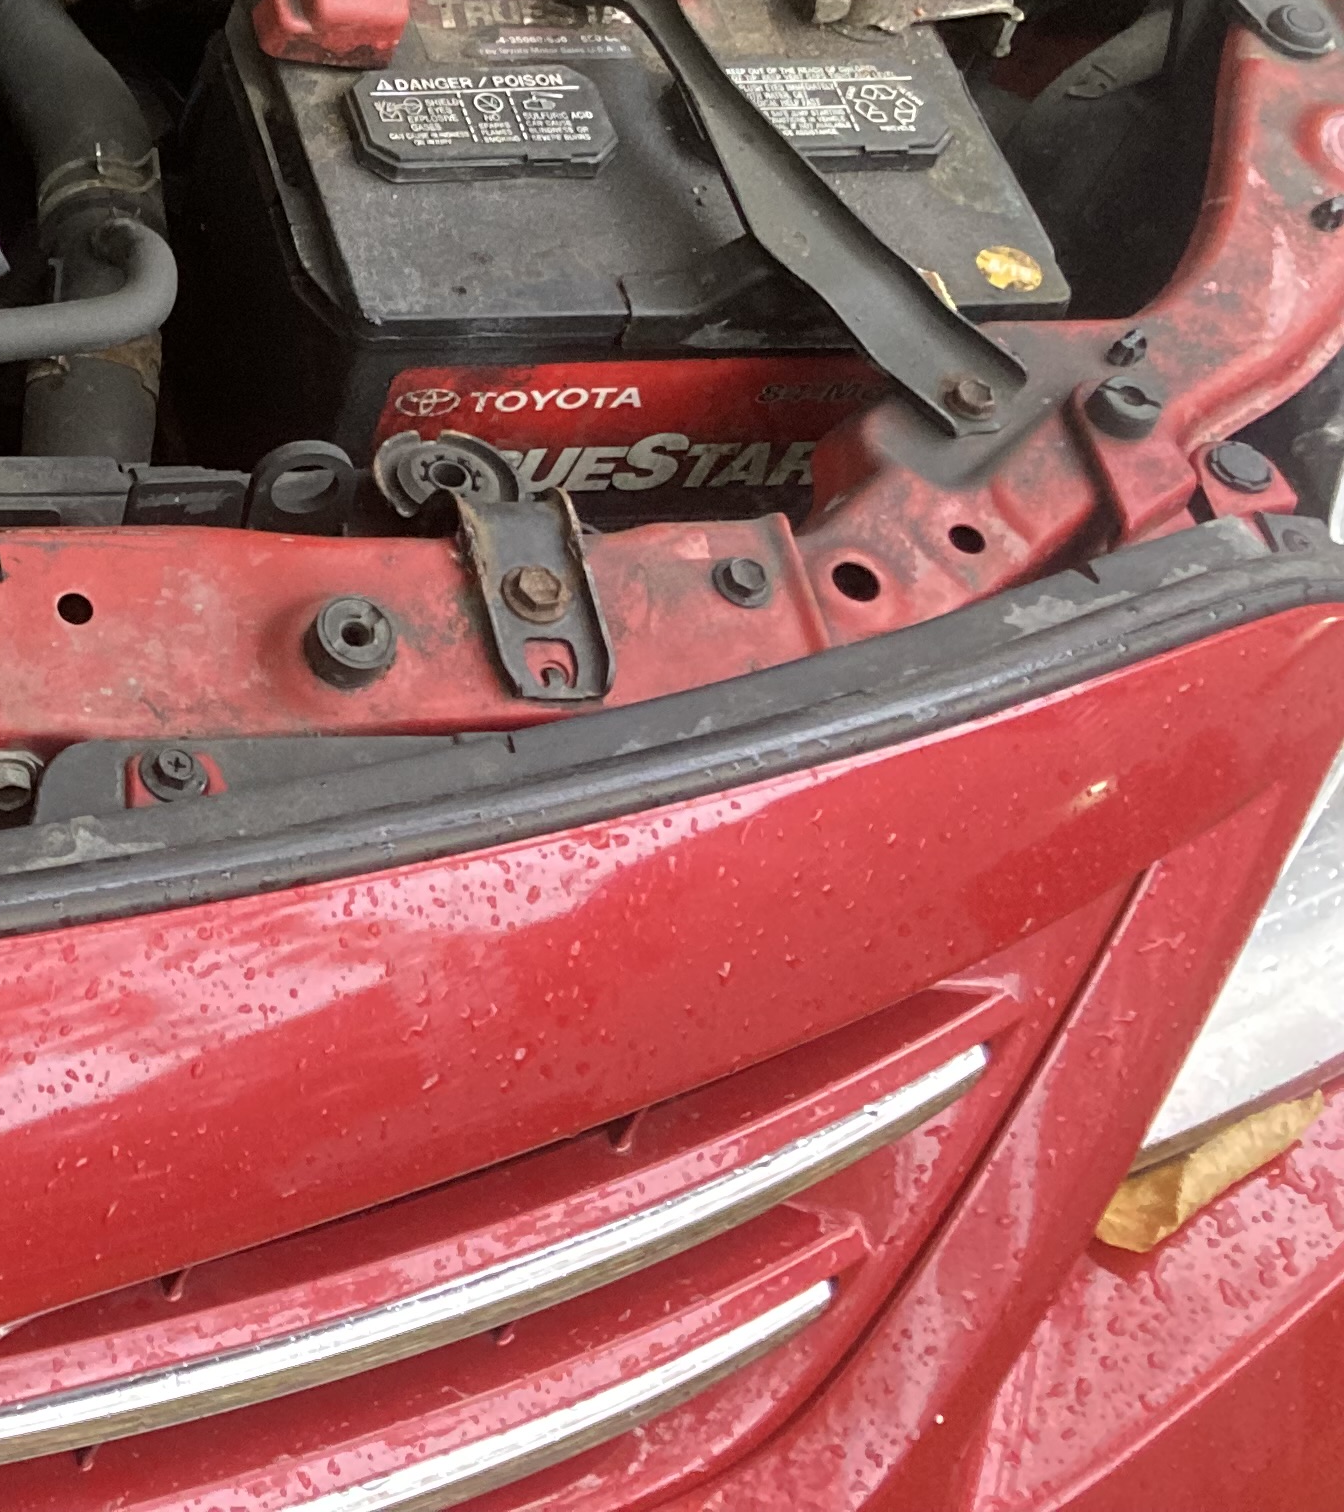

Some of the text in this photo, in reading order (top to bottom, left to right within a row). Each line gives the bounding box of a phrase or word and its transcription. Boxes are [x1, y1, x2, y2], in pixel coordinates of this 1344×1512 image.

[394, 73, 564, 91] DANGER / POISON
[424, 98, 461, 107] SHIELD
[428, 107, 453, 115] EYES
[522, 110, 594, 120] SULFURIC ACID
[407, 114, 459, 123] EXPLOSIVE
[483, 113, 501, 122] NO
[470, 387, 642, 413] TOYOTA
